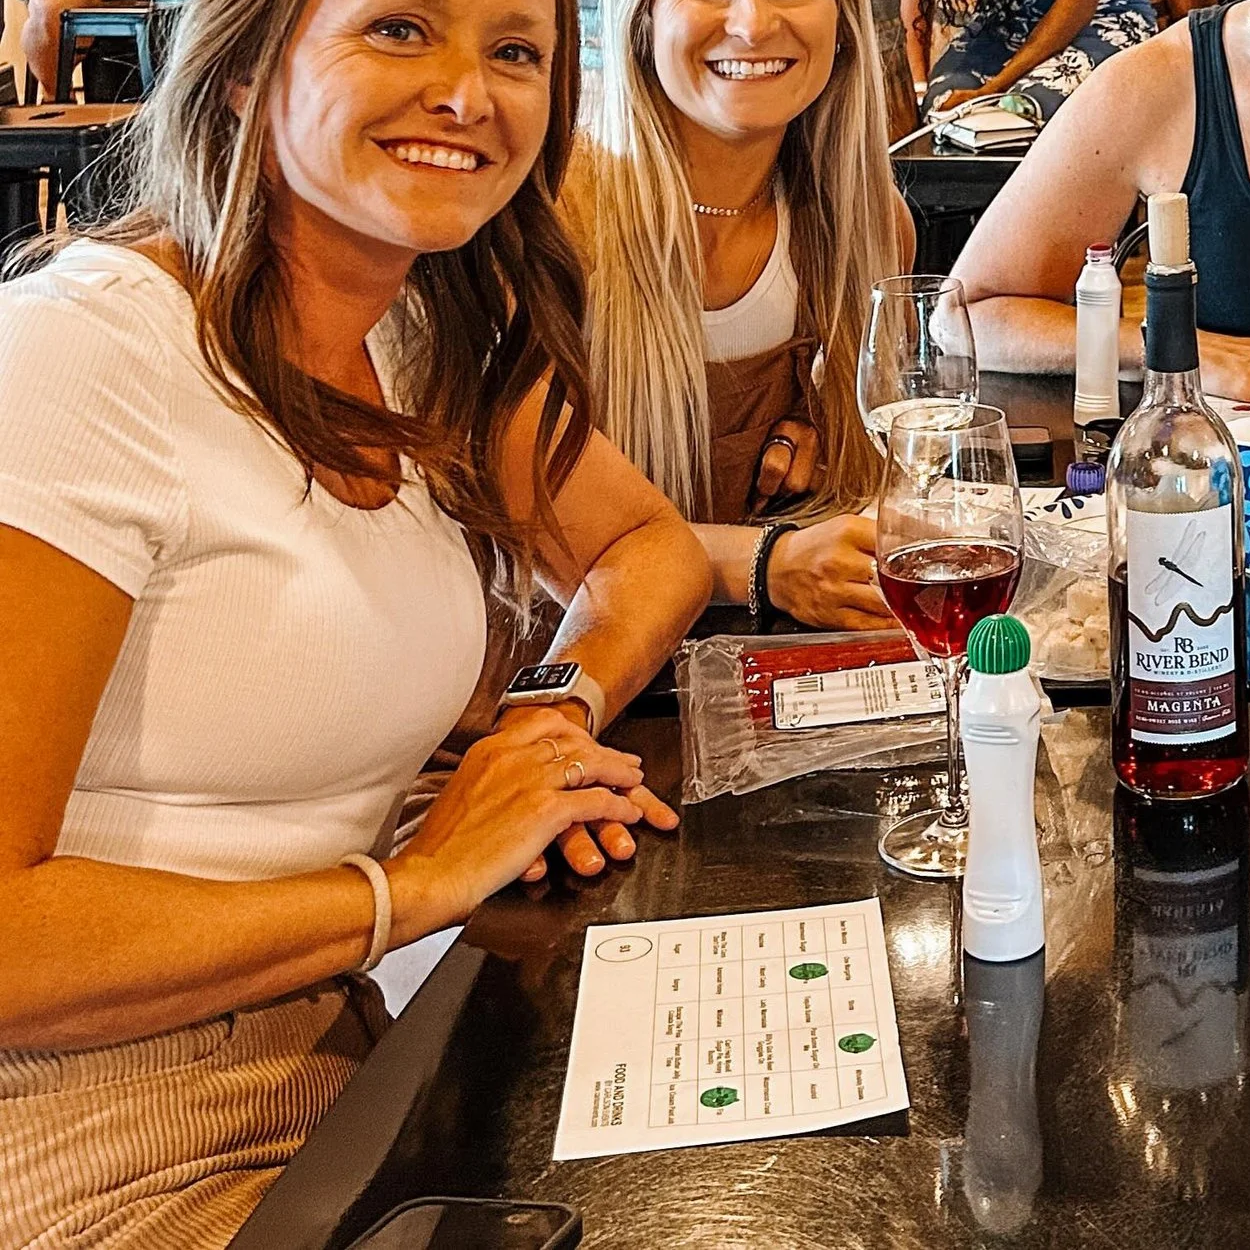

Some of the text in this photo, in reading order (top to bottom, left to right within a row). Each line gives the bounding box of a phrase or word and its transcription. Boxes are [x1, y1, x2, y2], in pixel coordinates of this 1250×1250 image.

[1174, 637, 1194, 653] RB
[1136, 647, 1229, 672] RIVER BEND
[1147, 696, 1221, 712] MAGENTA
[607, 1063, 627, 1126] FOOD AND DRINKS
